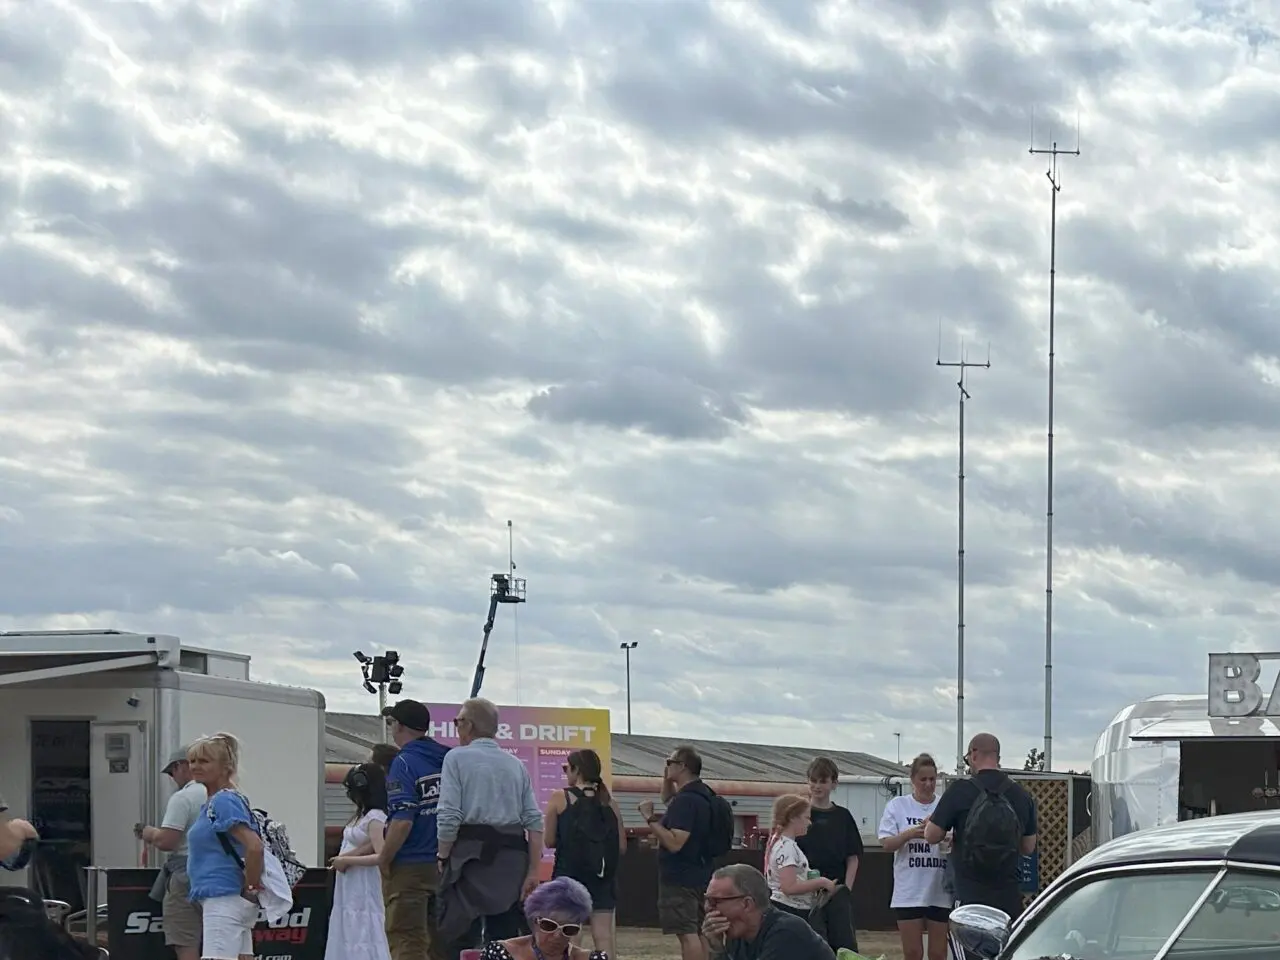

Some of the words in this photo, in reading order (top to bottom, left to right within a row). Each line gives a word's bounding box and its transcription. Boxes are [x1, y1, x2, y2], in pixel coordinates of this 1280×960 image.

[520, 724, 596, 743] DRIFT
[539, 748, 571, 756] SUNDAY
[908, 842, 931, 853] PINA
